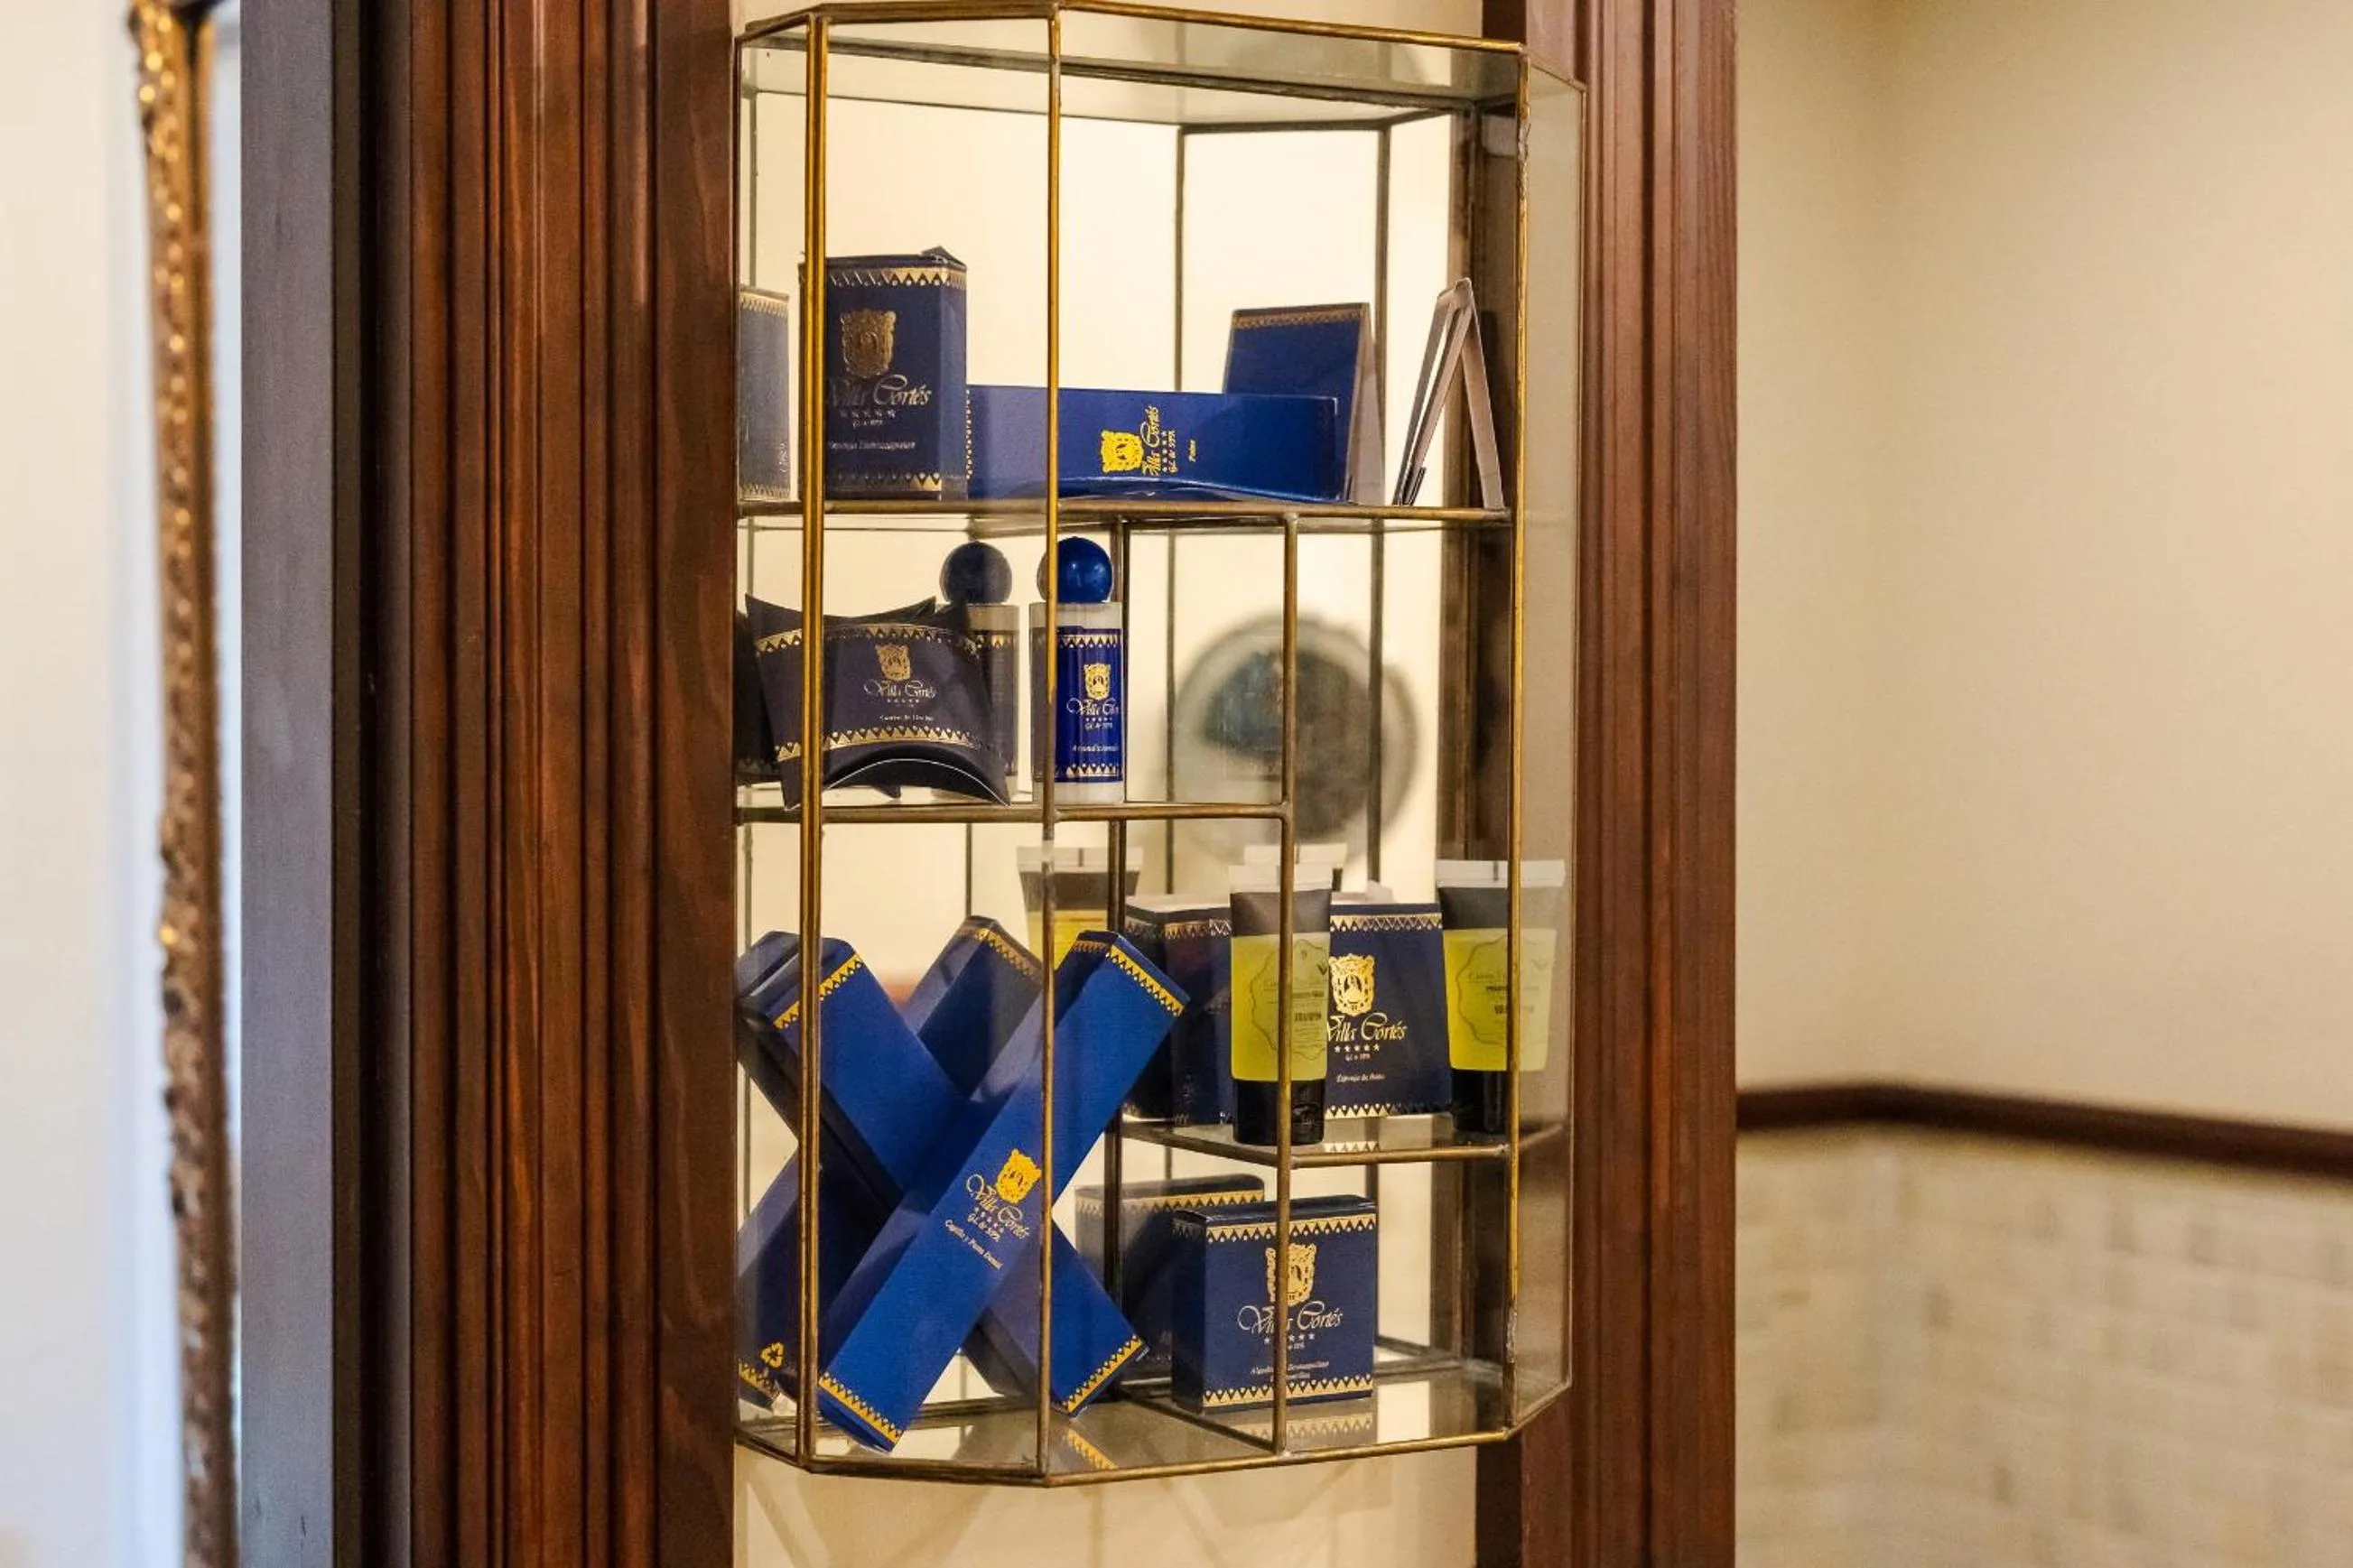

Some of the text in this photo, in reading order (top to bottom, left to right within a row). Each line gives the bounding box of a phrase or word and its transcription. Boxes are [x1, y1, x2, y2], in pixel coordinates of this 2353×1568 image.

[872, 374, 933, 406] Cortés
[1139, 404, 1161, 448] Cortés
[1325, 1012, 1409, 1043] Villa Cortés
[966, 1174, 1031, 1239] Villa Cortés
[1237, 1300, 1344, 1334] Via Cortés
